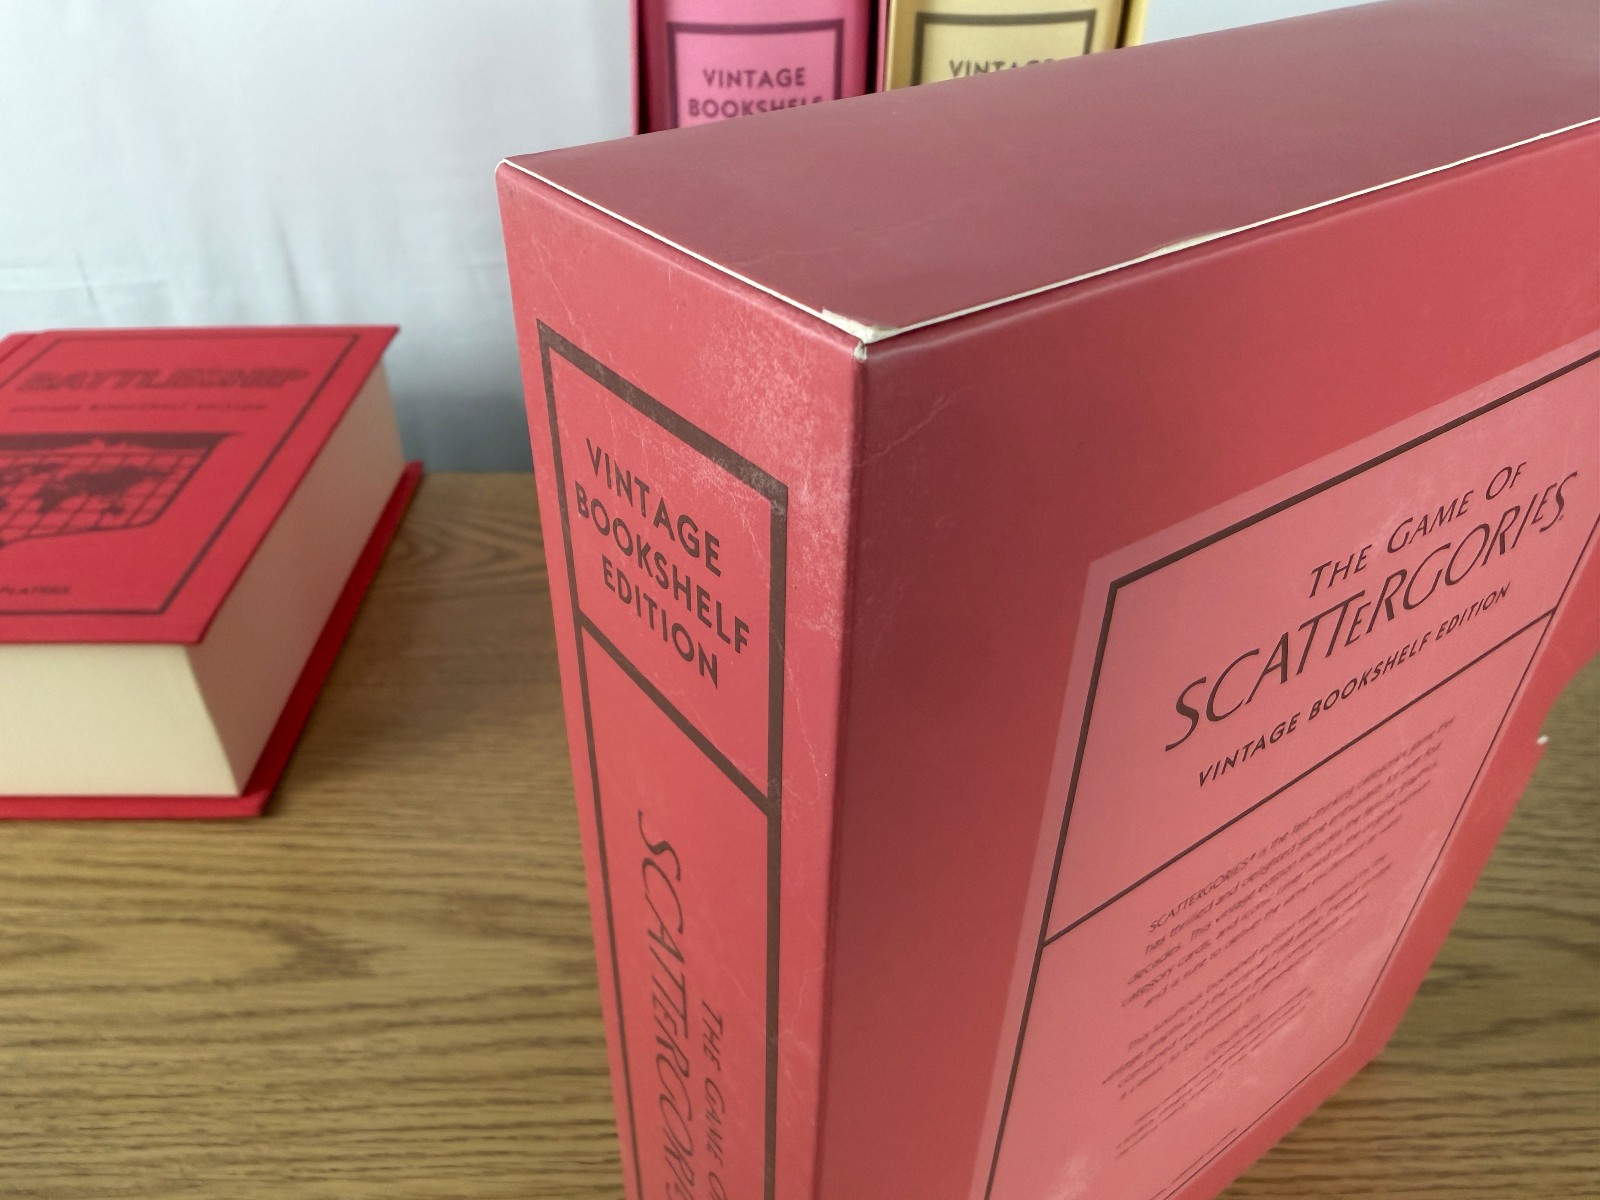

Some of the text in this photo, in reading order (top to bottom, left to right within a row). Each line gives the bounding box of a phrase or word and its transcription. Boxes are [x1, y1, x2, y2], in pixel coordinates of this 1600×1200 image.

[702, 67, 807, 88] VINTAGE
[948, 58, 1053, 77] VINT
[574, 480, 750, 654] BOOKSHELF
[585, 437, 722, 578] VINTAGE
[1308, 461, 1527, 599] THE GAME OF
[601, 554, 718, 690] EDITION
[1164, 470, 1578, 753] SCATTERGORIES
[1198, 712, 1302, 788] VINTAGE
[1307, 632, 1432, 722] BOOKSHELF
[1435, 581, 1511, 641] EDITION
[701, 998, 724, 1073] THE
[704, 1076, 726, 1168] GAME
